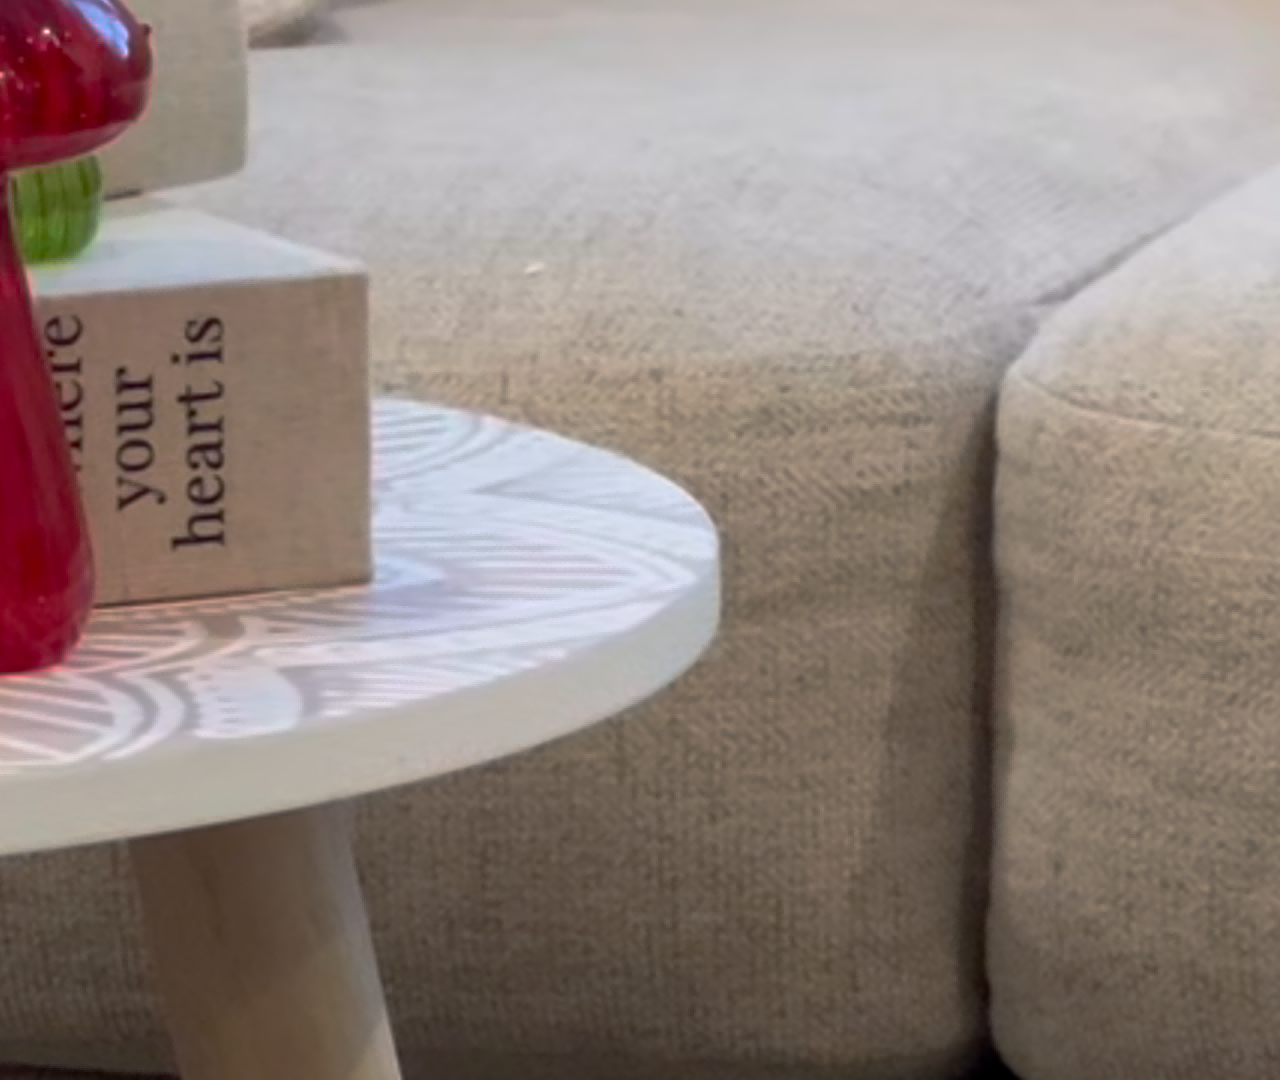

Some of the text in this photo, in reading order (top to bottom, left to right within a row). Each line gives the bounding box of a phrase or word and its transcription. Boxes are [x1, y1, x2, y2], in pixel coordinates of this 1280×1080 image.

[44, 314, 84, 472] ere
[115, 367, 166, 511] your
[170, 316, 224, 550] heart is
